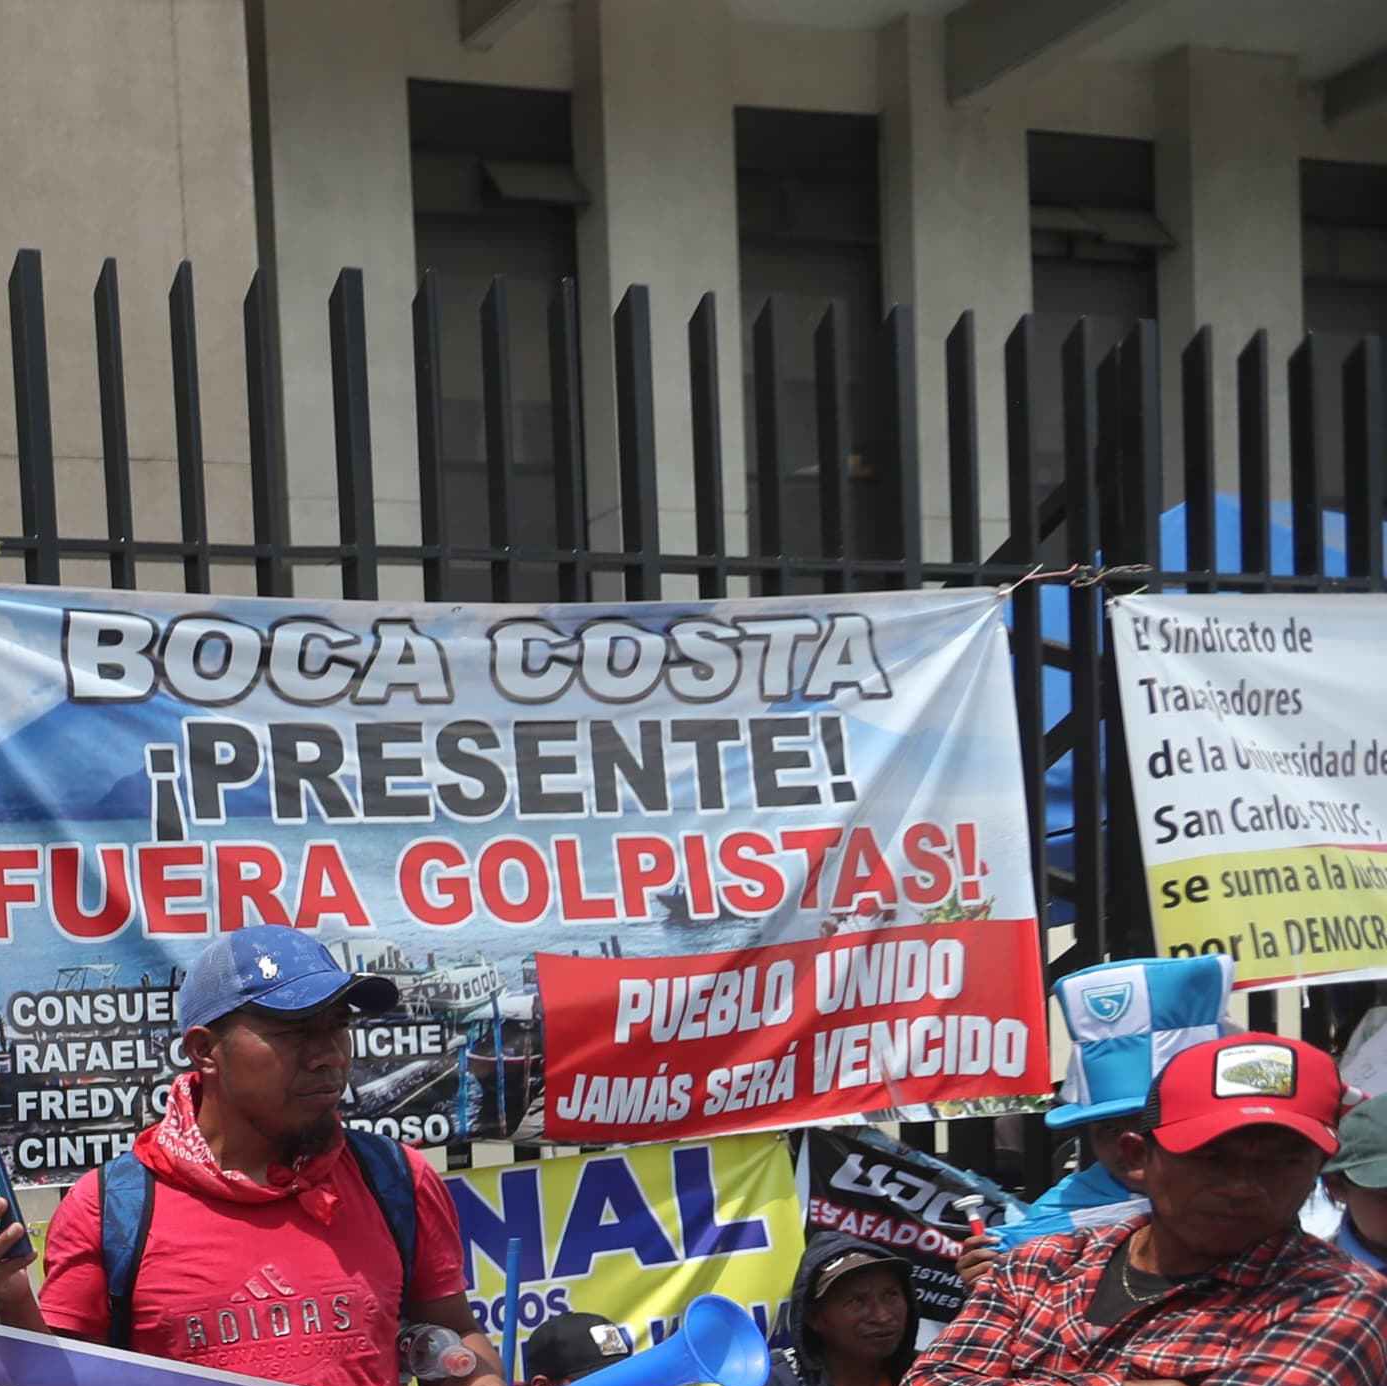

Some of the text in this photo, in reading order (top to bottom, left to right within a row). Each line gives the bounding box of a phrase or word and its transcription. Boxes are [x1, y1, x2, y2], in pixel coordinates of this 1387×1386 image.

[1159, 616, 1277, 654] Sindicato
[1283, 616, 1314, 653] de
[64, 609, 894, 707] BOCA COSTA
[1138, 677, 1304, 722] Trabajadores
[146, 713, 857, 841] ¡PRESENTE!
[1148, 738, 1195, 780] de
[1197, 736, 1228, 773] la
[1231, 736, 1357, 778] Universidad
[1154, 804, 1225, 845] San
[396, 820, 987, 931] GOLPISTAS!
[1162, 873, 1210, 909] se
[1221, 864, 1300, 899] suma
[1305, 864, 1322, 892] a
[1321, 853, 1347, 890] la
[1250, 921, 1280, 960] la
[12, 991, 178, 1027] CONSUE
[614, 938, 965, 1045] PUEBLO UNIDO
[15, 1039, 158, 1075] RAFAEL
[555, 1015, 1030, 1126] JAMÁS SERÁ VENCIDO
[17, 1085, 140, 1122] FREDY
[185, 1295, 352, 1349] ADIDAS
